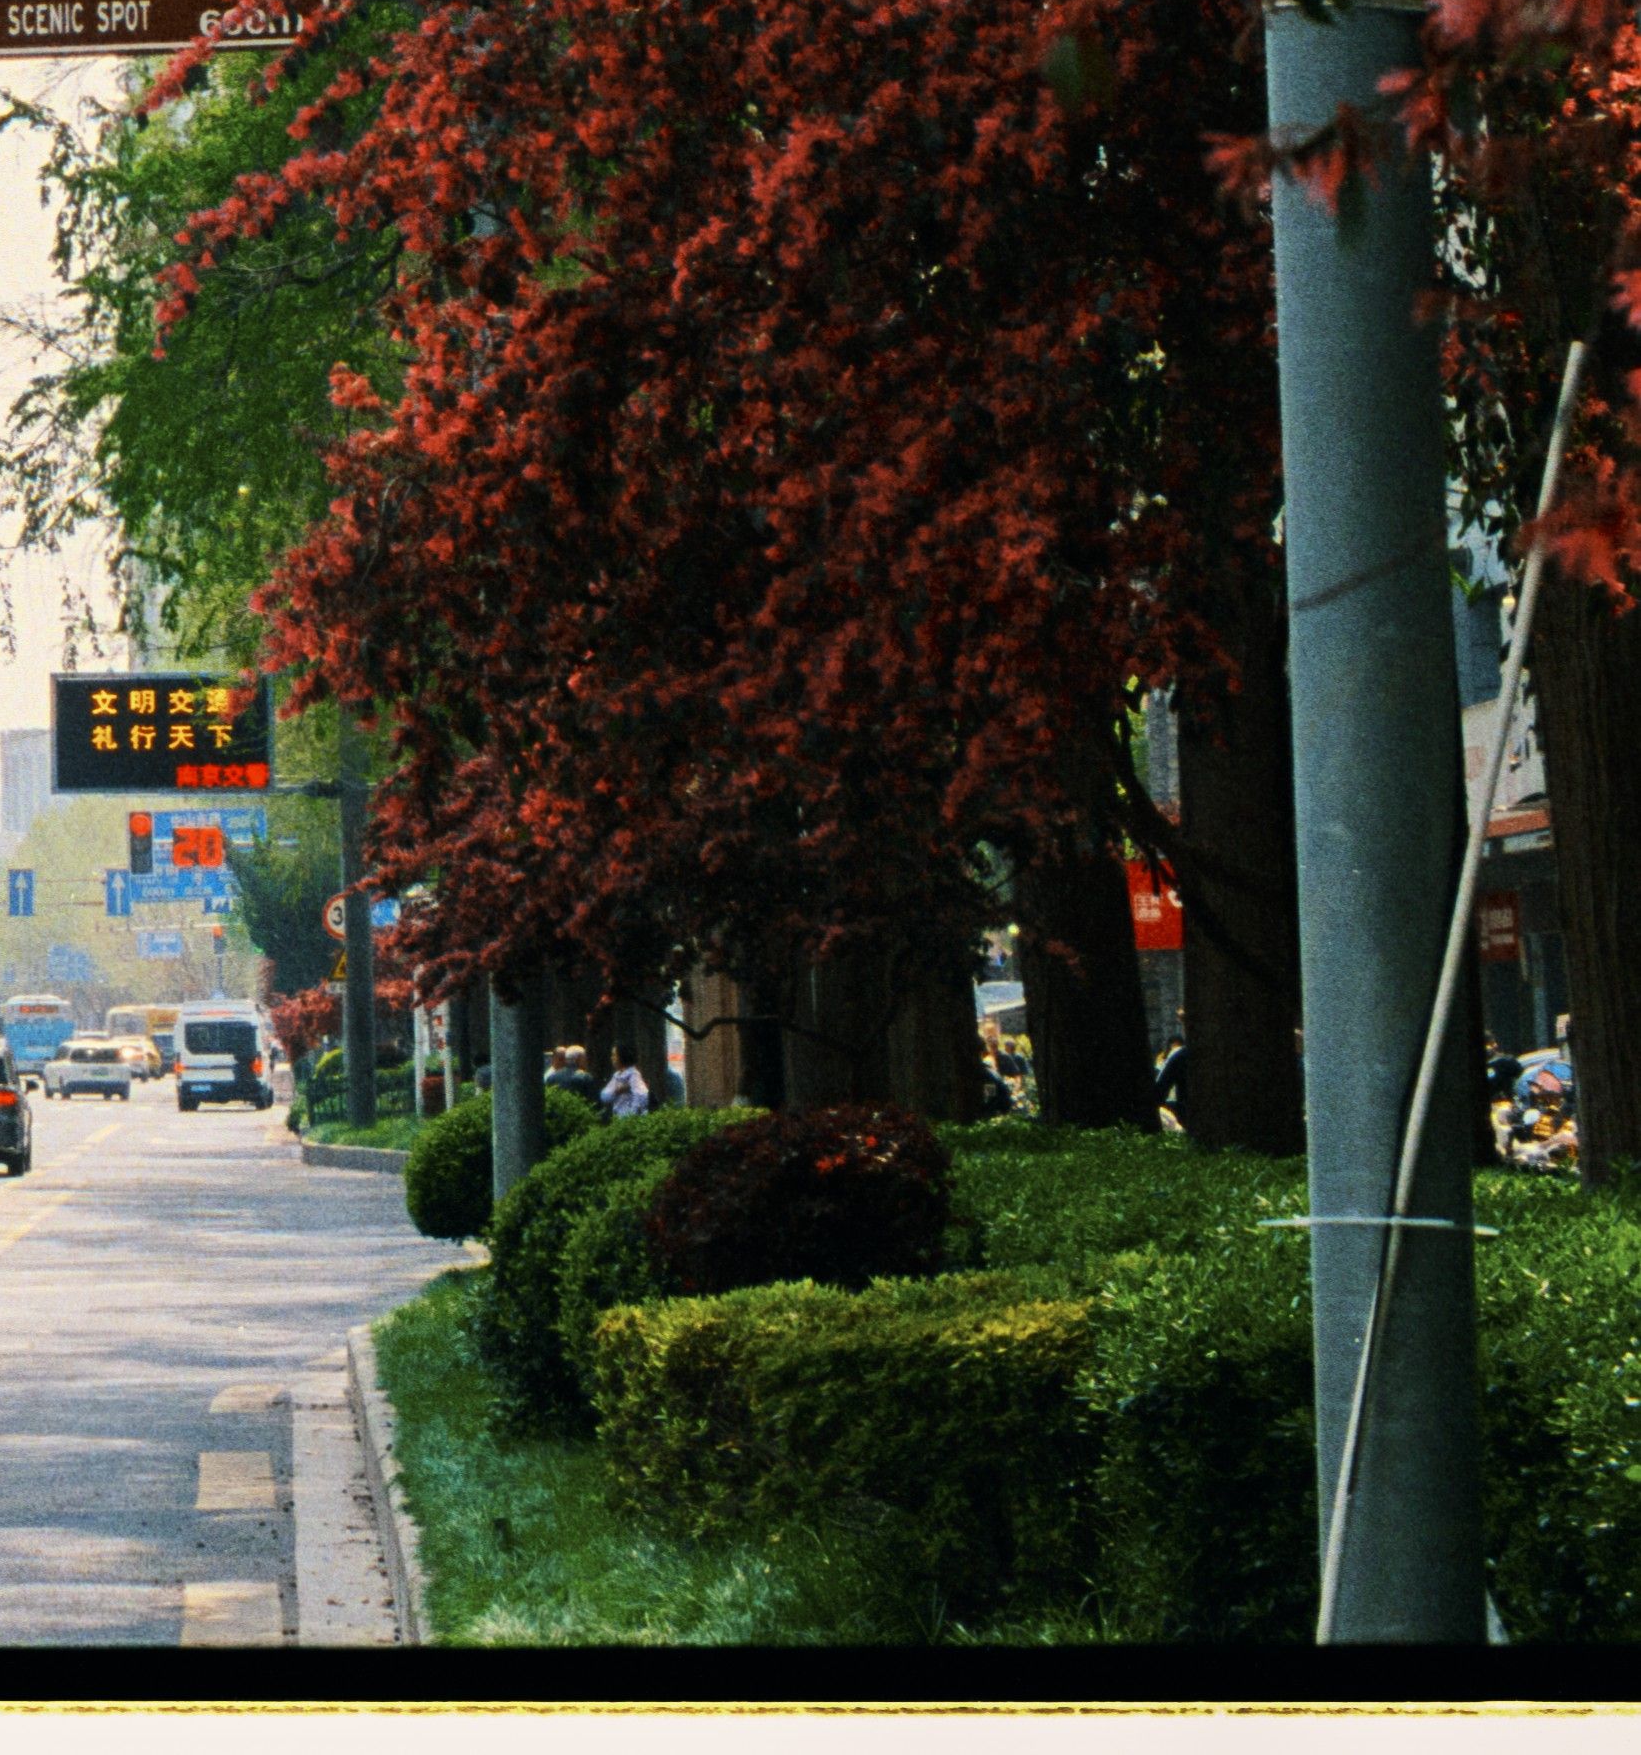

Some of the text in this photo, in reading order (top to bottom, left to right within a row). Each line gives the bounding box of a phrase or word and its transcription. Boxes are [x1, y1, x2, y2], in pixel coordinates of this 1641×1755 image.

[8, 2, 85, 37] SCENIC
[97, 0, 151, 33] SPOT
[91, 724, 234, 750] 礼行天下
[173, 827, 225, 868] 20
